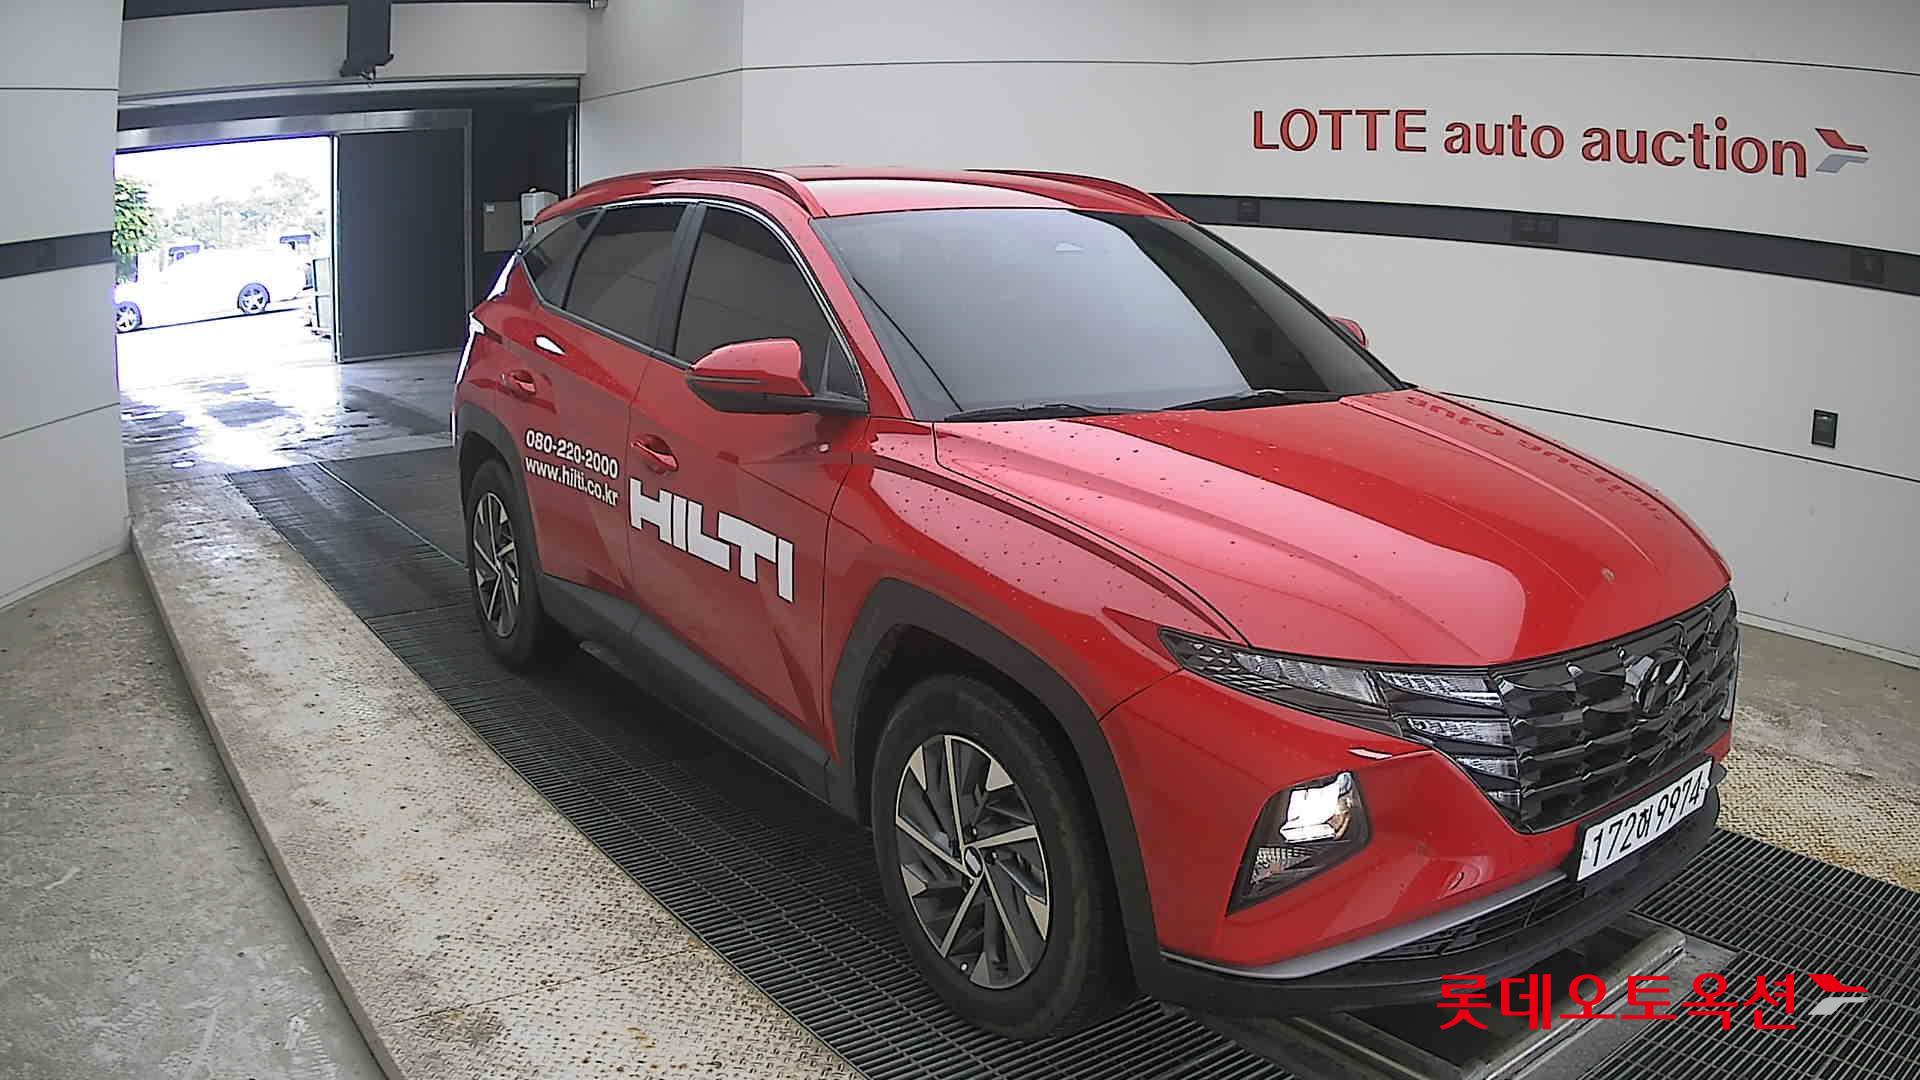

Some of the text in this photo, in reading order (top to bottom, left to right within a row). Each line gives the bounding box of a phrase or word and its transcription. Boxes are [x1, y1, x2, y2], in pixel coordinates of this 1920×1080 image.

[1252, 108, 1808, 179] LOTTE auto auction
[524, 456, 619, 507] www.hilti.co.kr
[525, 429, 619, 479] 080-220-2000
[629, 477, 795, 603] HILTI
